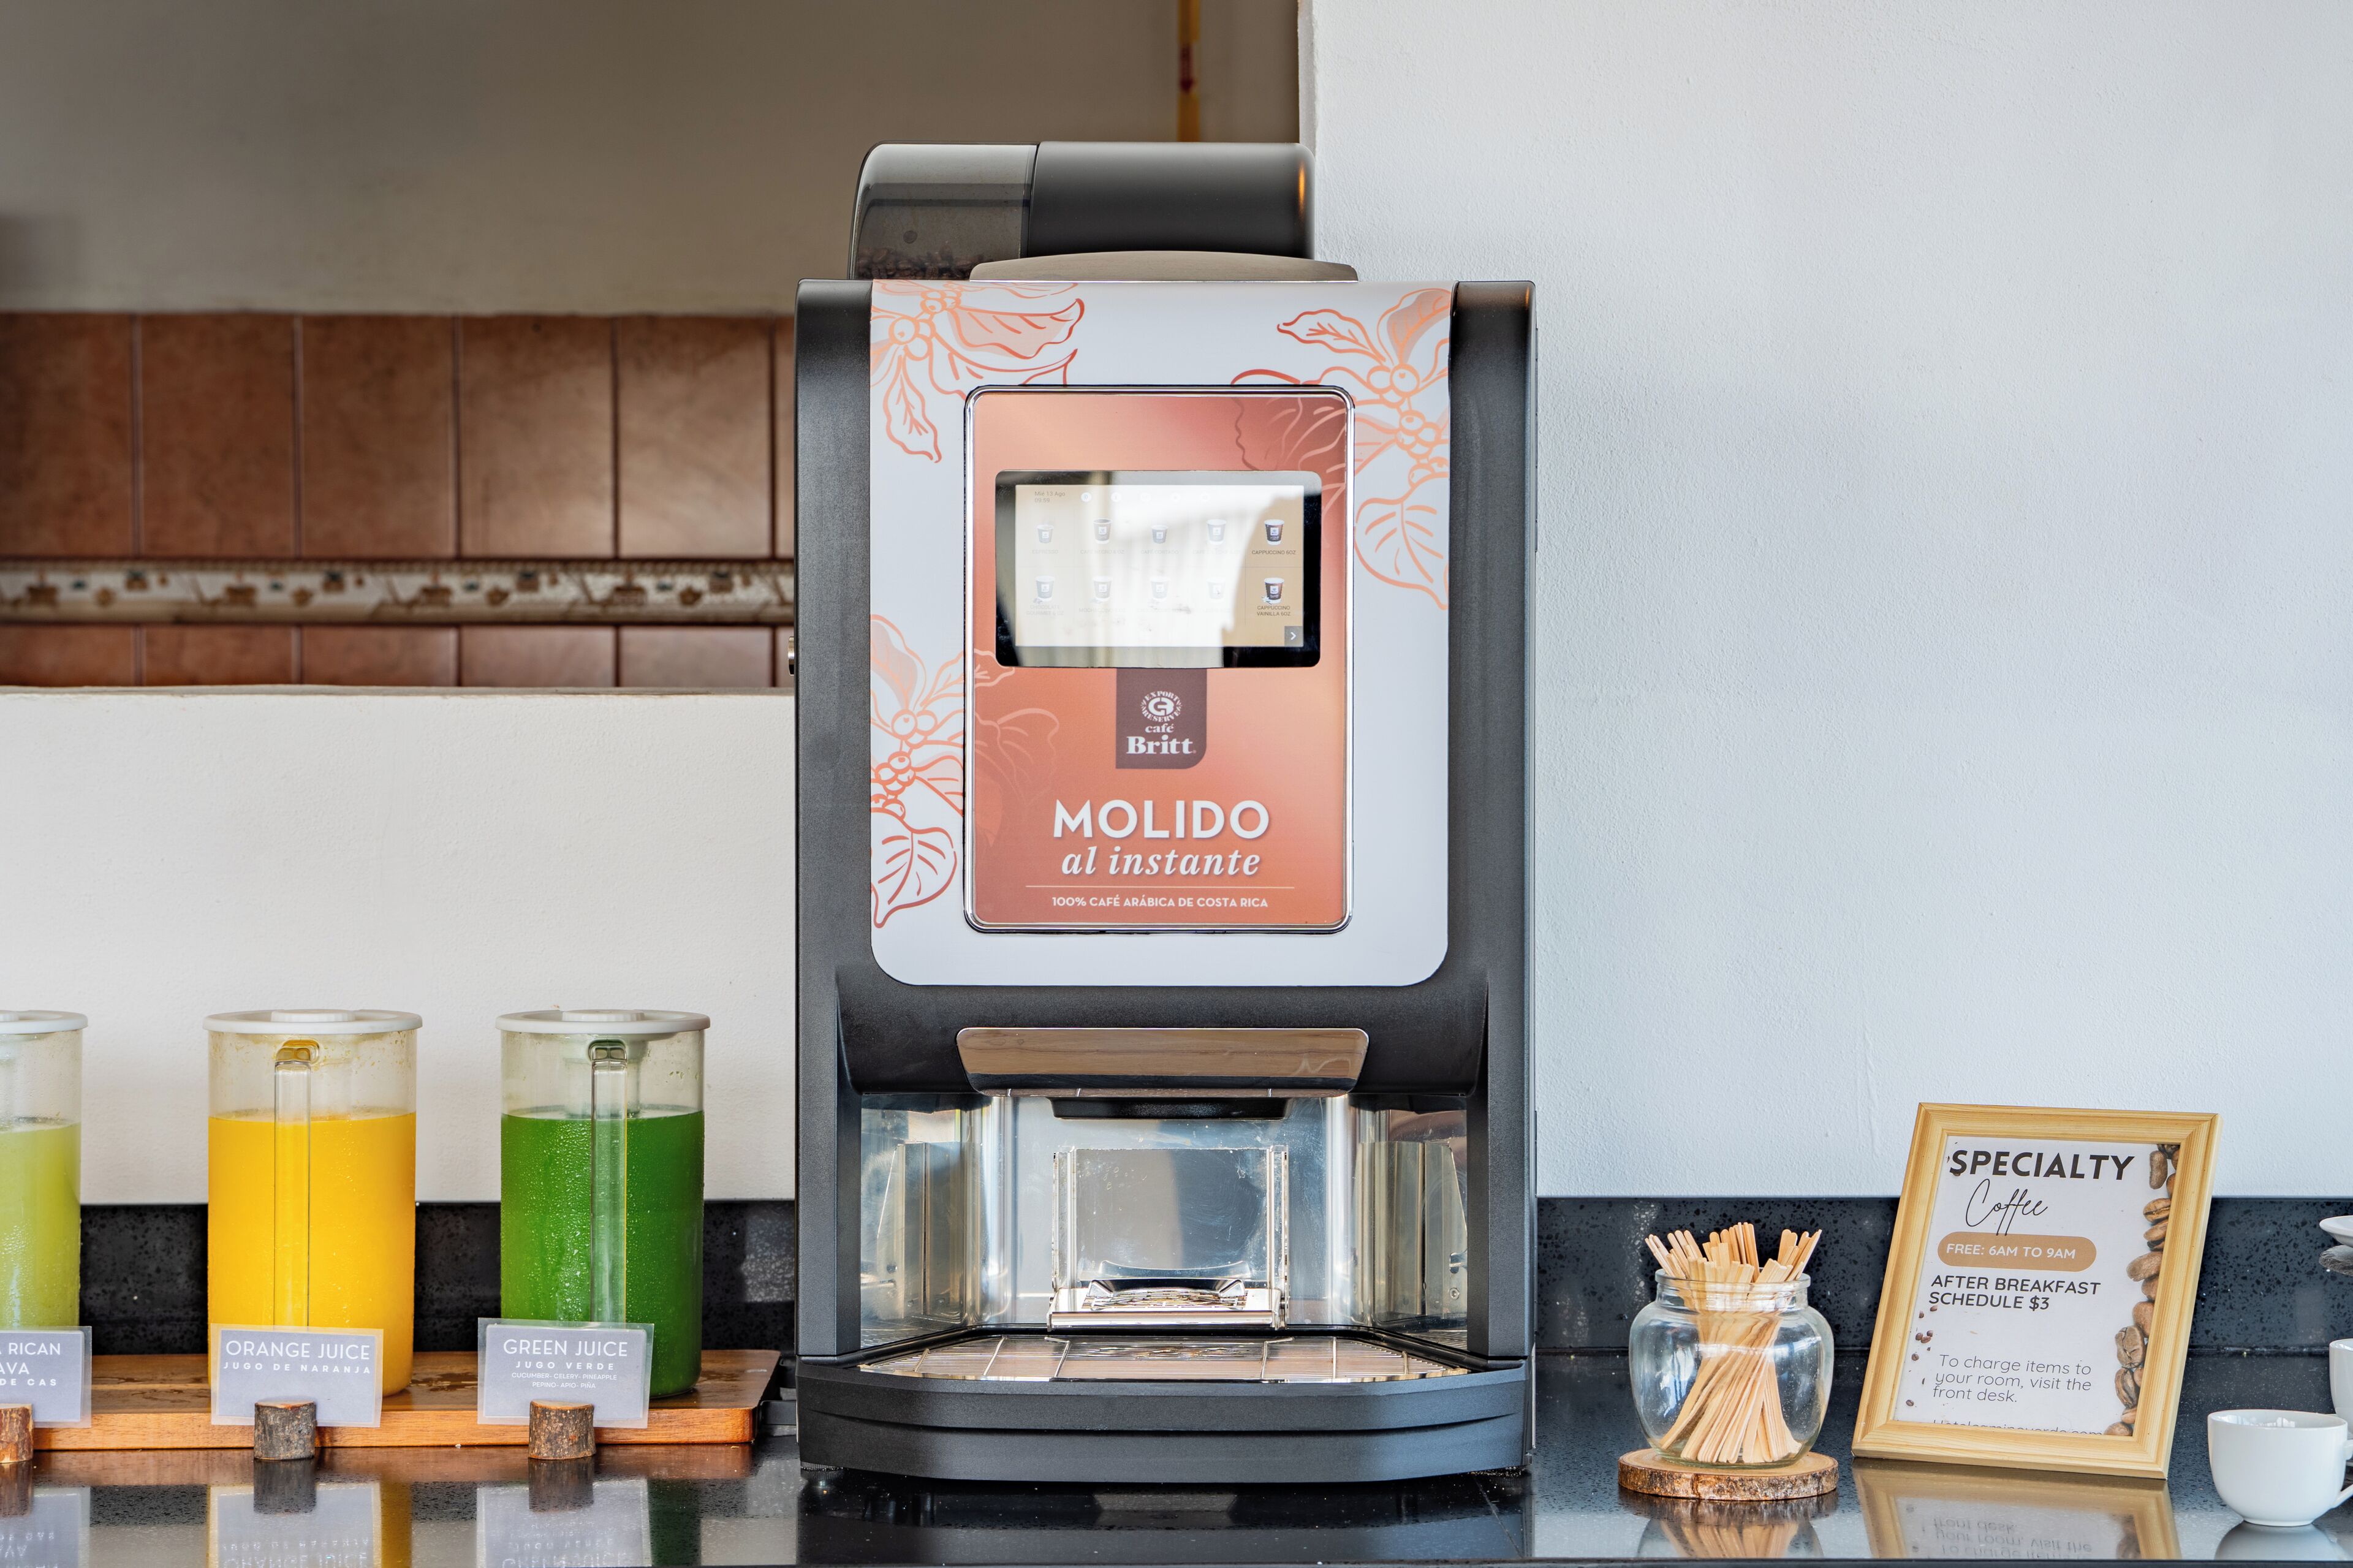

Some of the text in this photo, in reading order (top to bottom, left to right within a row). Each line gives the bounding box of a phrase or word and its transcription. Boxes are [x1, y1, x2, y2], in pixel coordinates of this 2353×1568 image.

[1144, 691, 1180, 702] EXPORT
[1142, 710, 1180, 722] RESERVE
[1145, 723, 1174, 733] café
[1053, 799, 1269, 839] MOLIDO
[1061, 846, 1260, 876] al instante
[1052, 895, 1268, 907] 100% CAFÉ ARÁBICA DE COSTA RICA
[1949, 1149, 2135, 1181] SPECIALTY
[1966, 1178, 2048, 1236] Coffee
[1946, 1243, 2076, 1259] FREE: 6AM TO 9AM
[1931, 1275, 2101, 1295] AFTER BREAKFAST
[1928, 1291, 2050, 1311] SCHEDULE $3
[9, 1342, 60, 1355] RICAN
[225, 1340, 370, 1360] ORANGE JUICE
[503, 1339, 628, 1357] GREEN JUICE
[224, 1362, 263, 1371] JUGO
[300, 1365, 371, 1374] NARANJA
[1939, 1354, 2091, 1375] To charge items to
[1934, 1373, 2091, 1390] your room, visit the
[1933, 1385, 2017, 1403] front desk.
